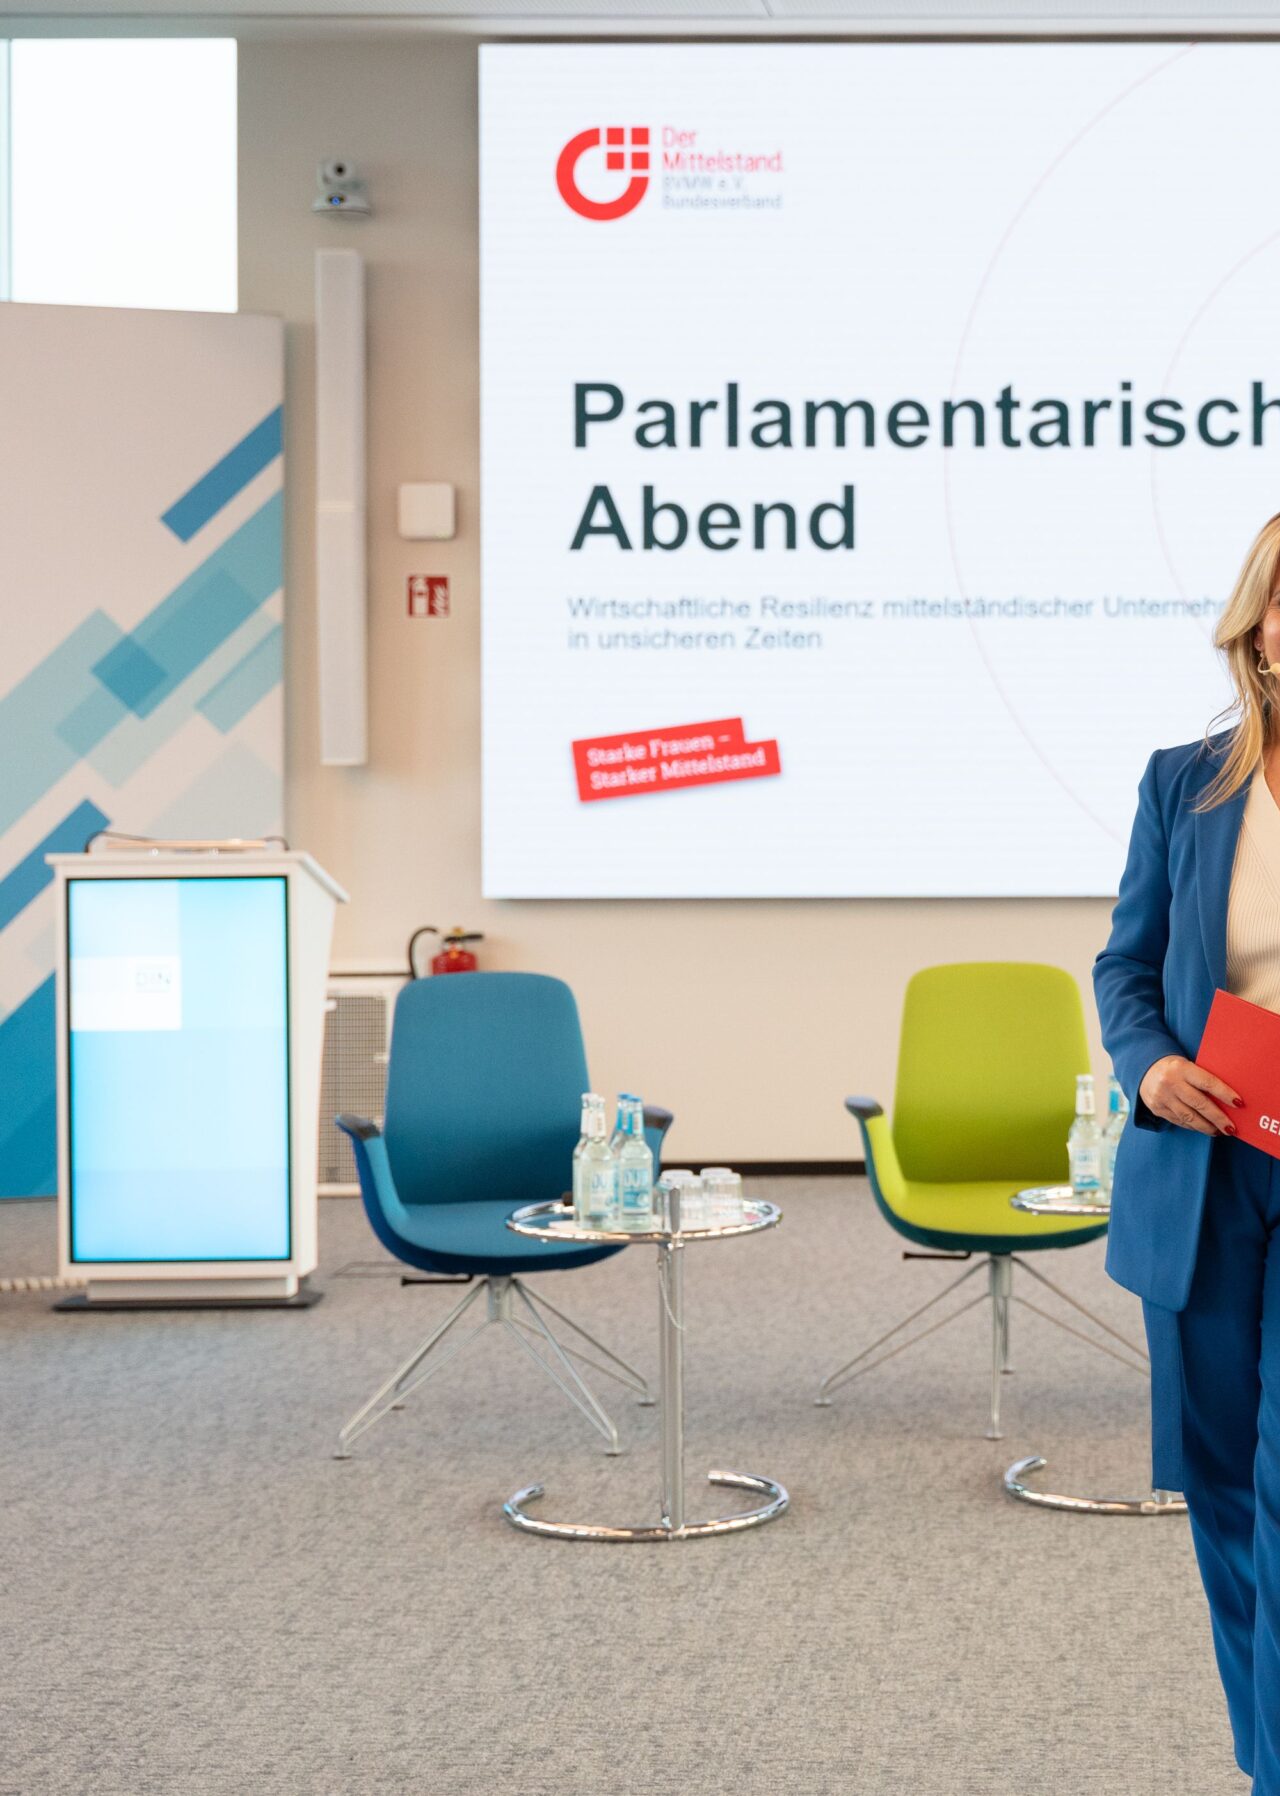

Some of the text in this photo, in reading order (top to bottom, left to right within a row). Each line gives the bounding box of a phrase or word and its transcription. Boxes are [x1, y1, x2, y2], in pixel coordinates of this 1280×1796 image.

[662, 126, 697, 147] Der
[569, 484, 857, 552] Abend
[566, 596, 752, 618] Wirtschaftliche
[760, 596, 876, 618] Resilienz
[882, 596, 1095, 618] mittelständischer
[567, 627, 823, 649] in unsicheren Zeiten
[587, 742, 646, 767] Starke
[649, 734, 714, 758] Frauen
[590, 747, 766, 790] Starker Mittelstand
